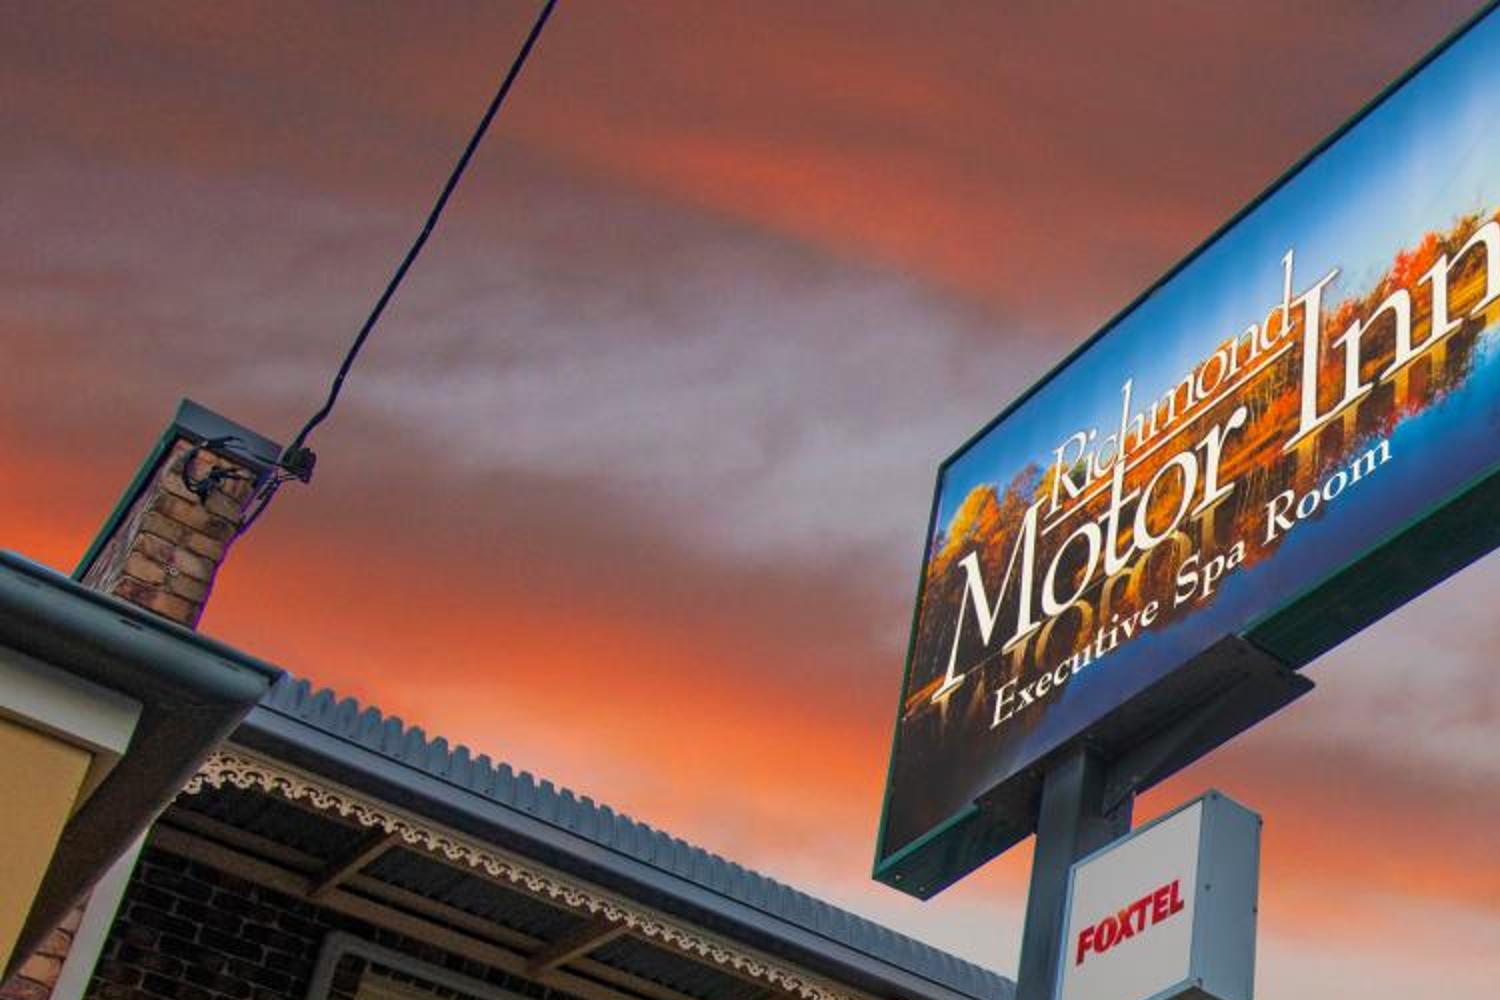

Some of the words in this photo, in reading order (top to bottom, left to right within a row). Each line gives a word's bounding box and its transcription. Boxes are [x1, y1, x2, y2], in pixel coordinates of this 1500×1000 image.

[1046, 249, 1297, 519] Richmond
[931, 405, 1248, 703] Motor
[990, 600, 1159, 731] Executive
[1174, 540, 1247, 609] Spa
[1264, 437, 1393, 546] Room
[1076, 880, 1184, 966] FOXTEL
